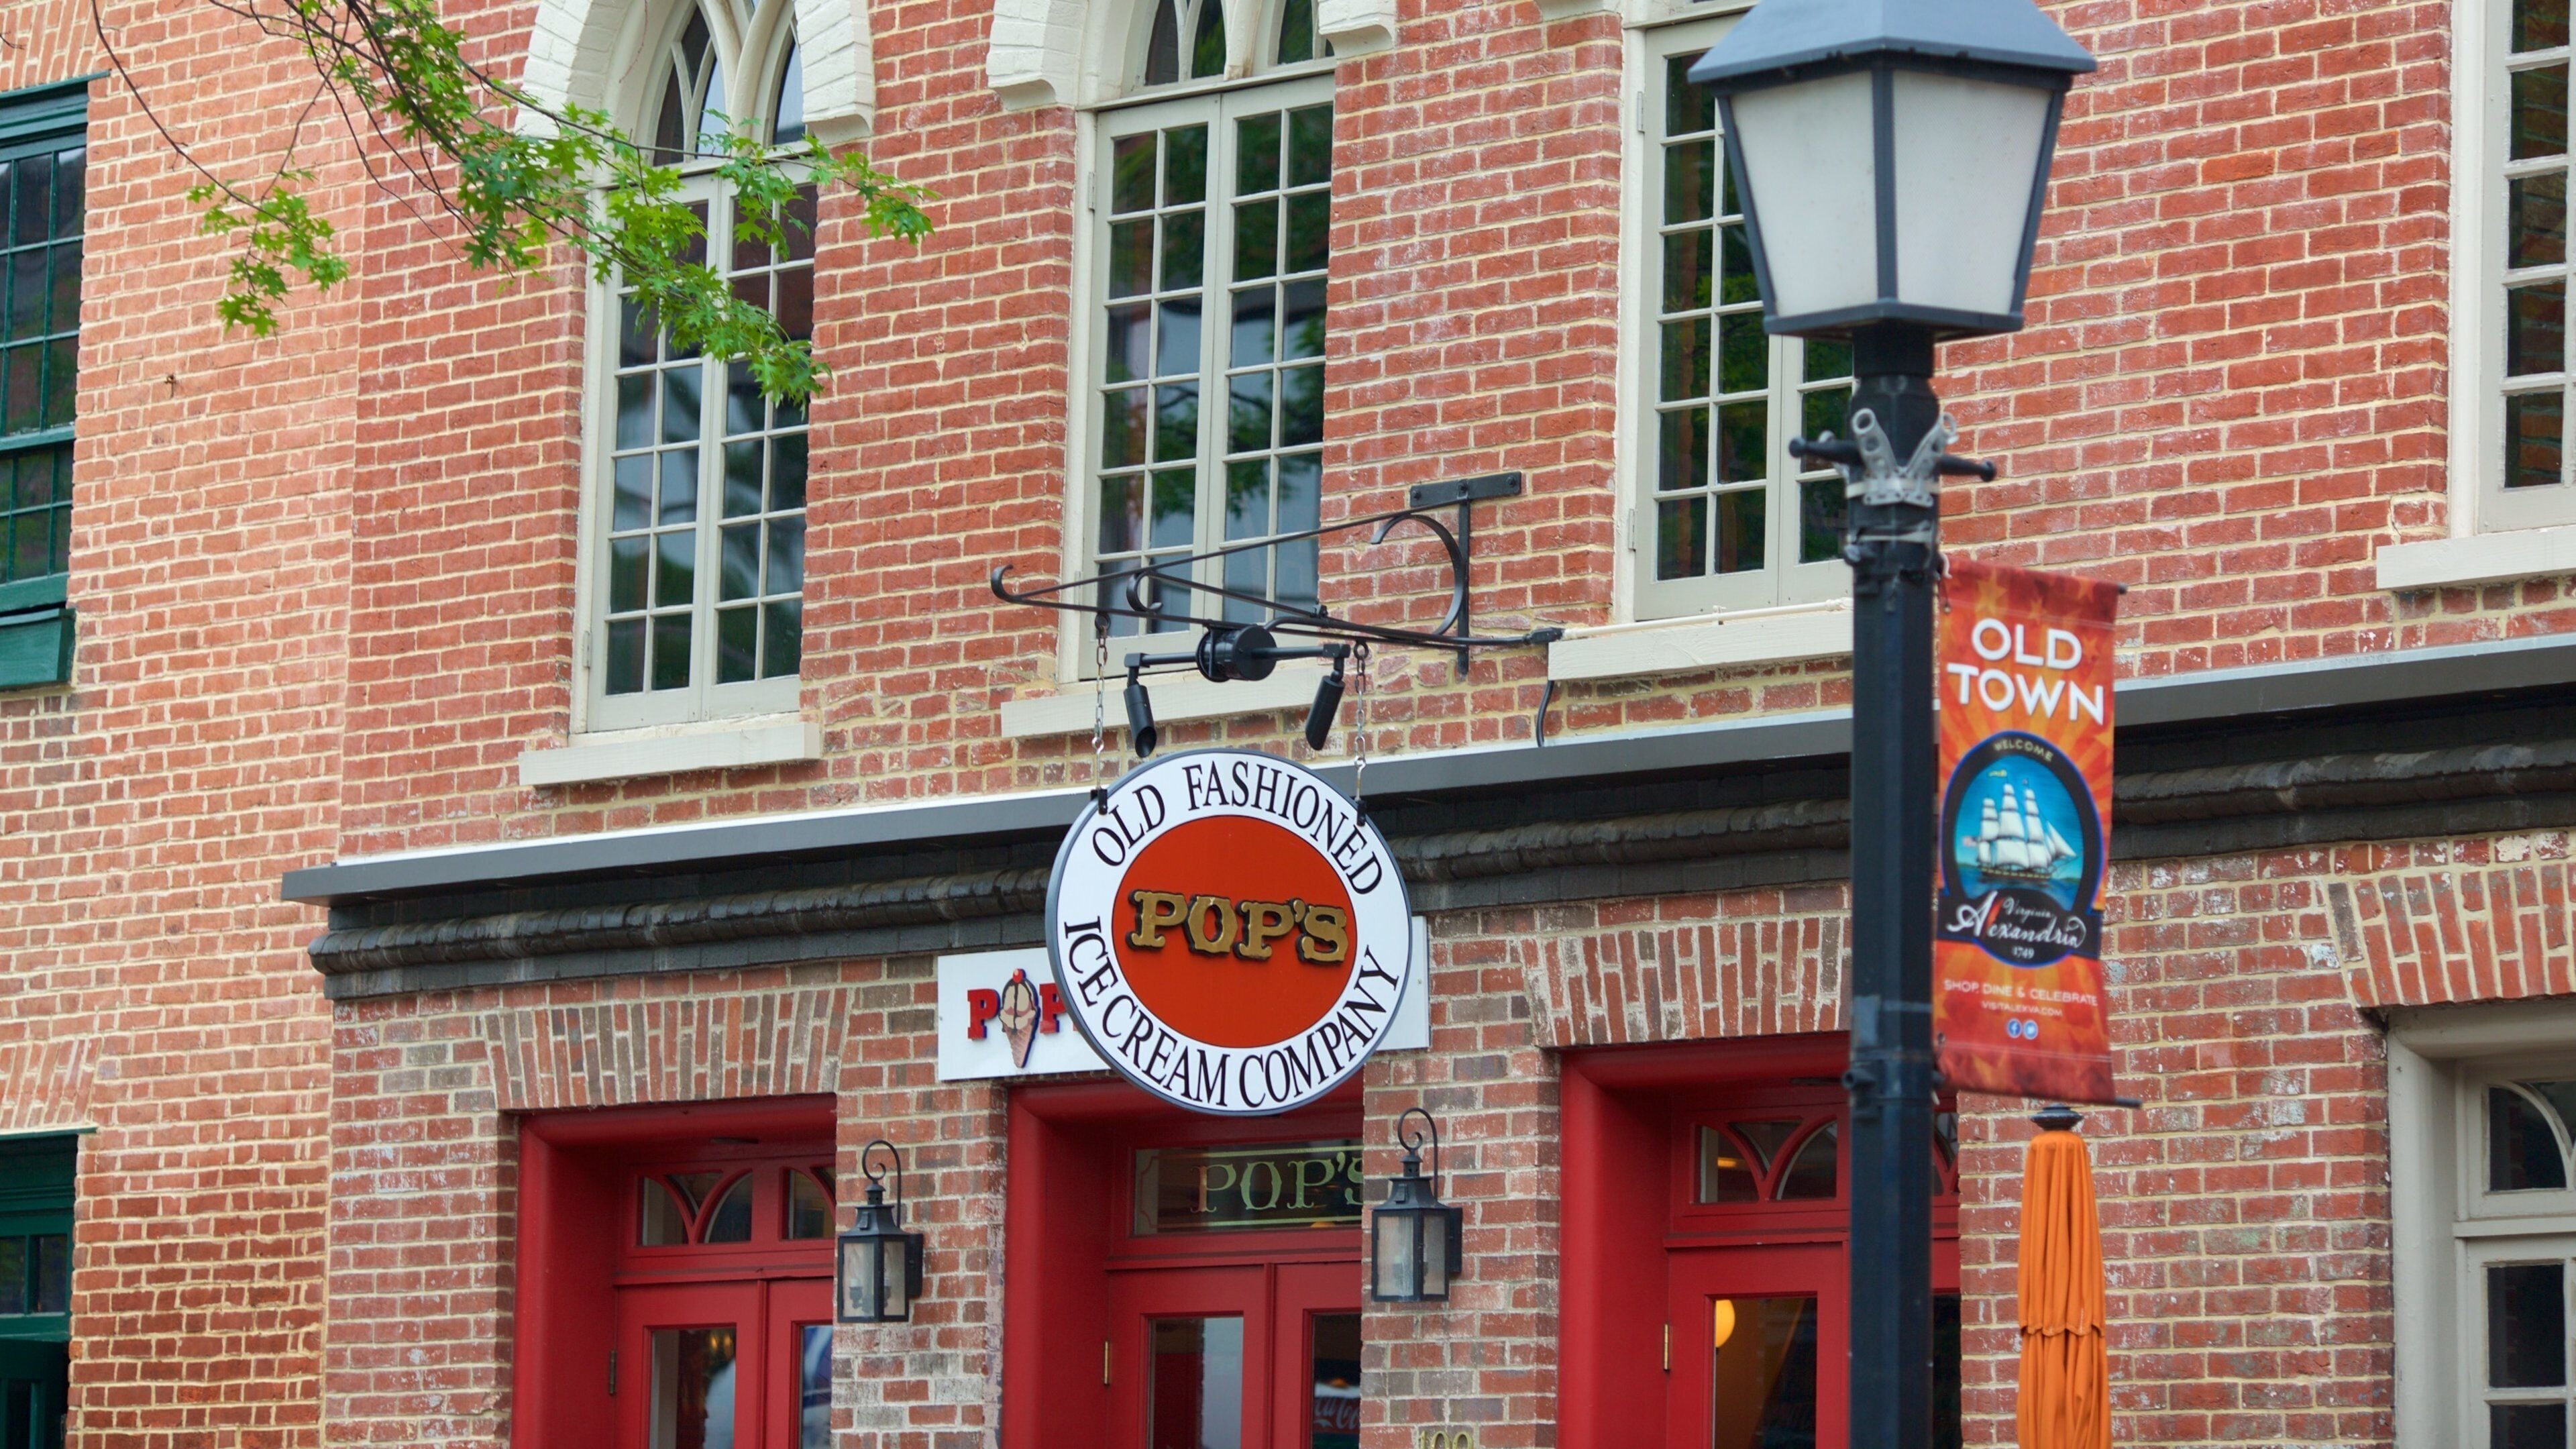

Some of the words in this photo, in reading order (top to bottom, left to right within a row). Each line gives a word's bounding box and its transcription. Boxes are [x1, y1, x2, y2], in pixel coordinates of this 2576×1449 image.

[1972, 618, 2082, 669] OLD
[1947, 663, 2104, 725] TOWN
[1994, 739, 2053, 761] WELCOME
[1091, 784, 1166, 867] OLD
[1182, 761, 1383, 895] FASHIONED
[1128, 890, 1348, 964] POP'S
[1946, 890, 2086, 948] Alexandria
[2002, 896, 2053, 923] Virginia
[2012, 946, 2035, 959] 1749
[1064, 916, 1114, 1007] ICE
[1102, 995, 1230, 1107] CREAM
[1239, 945, 1399, 1107] COMPANY
[1982, 983, 2012, 996] DINE
[2017, 987, 2026, 998] &
[2030, 988, 2098, 1006] CELEBRATE
